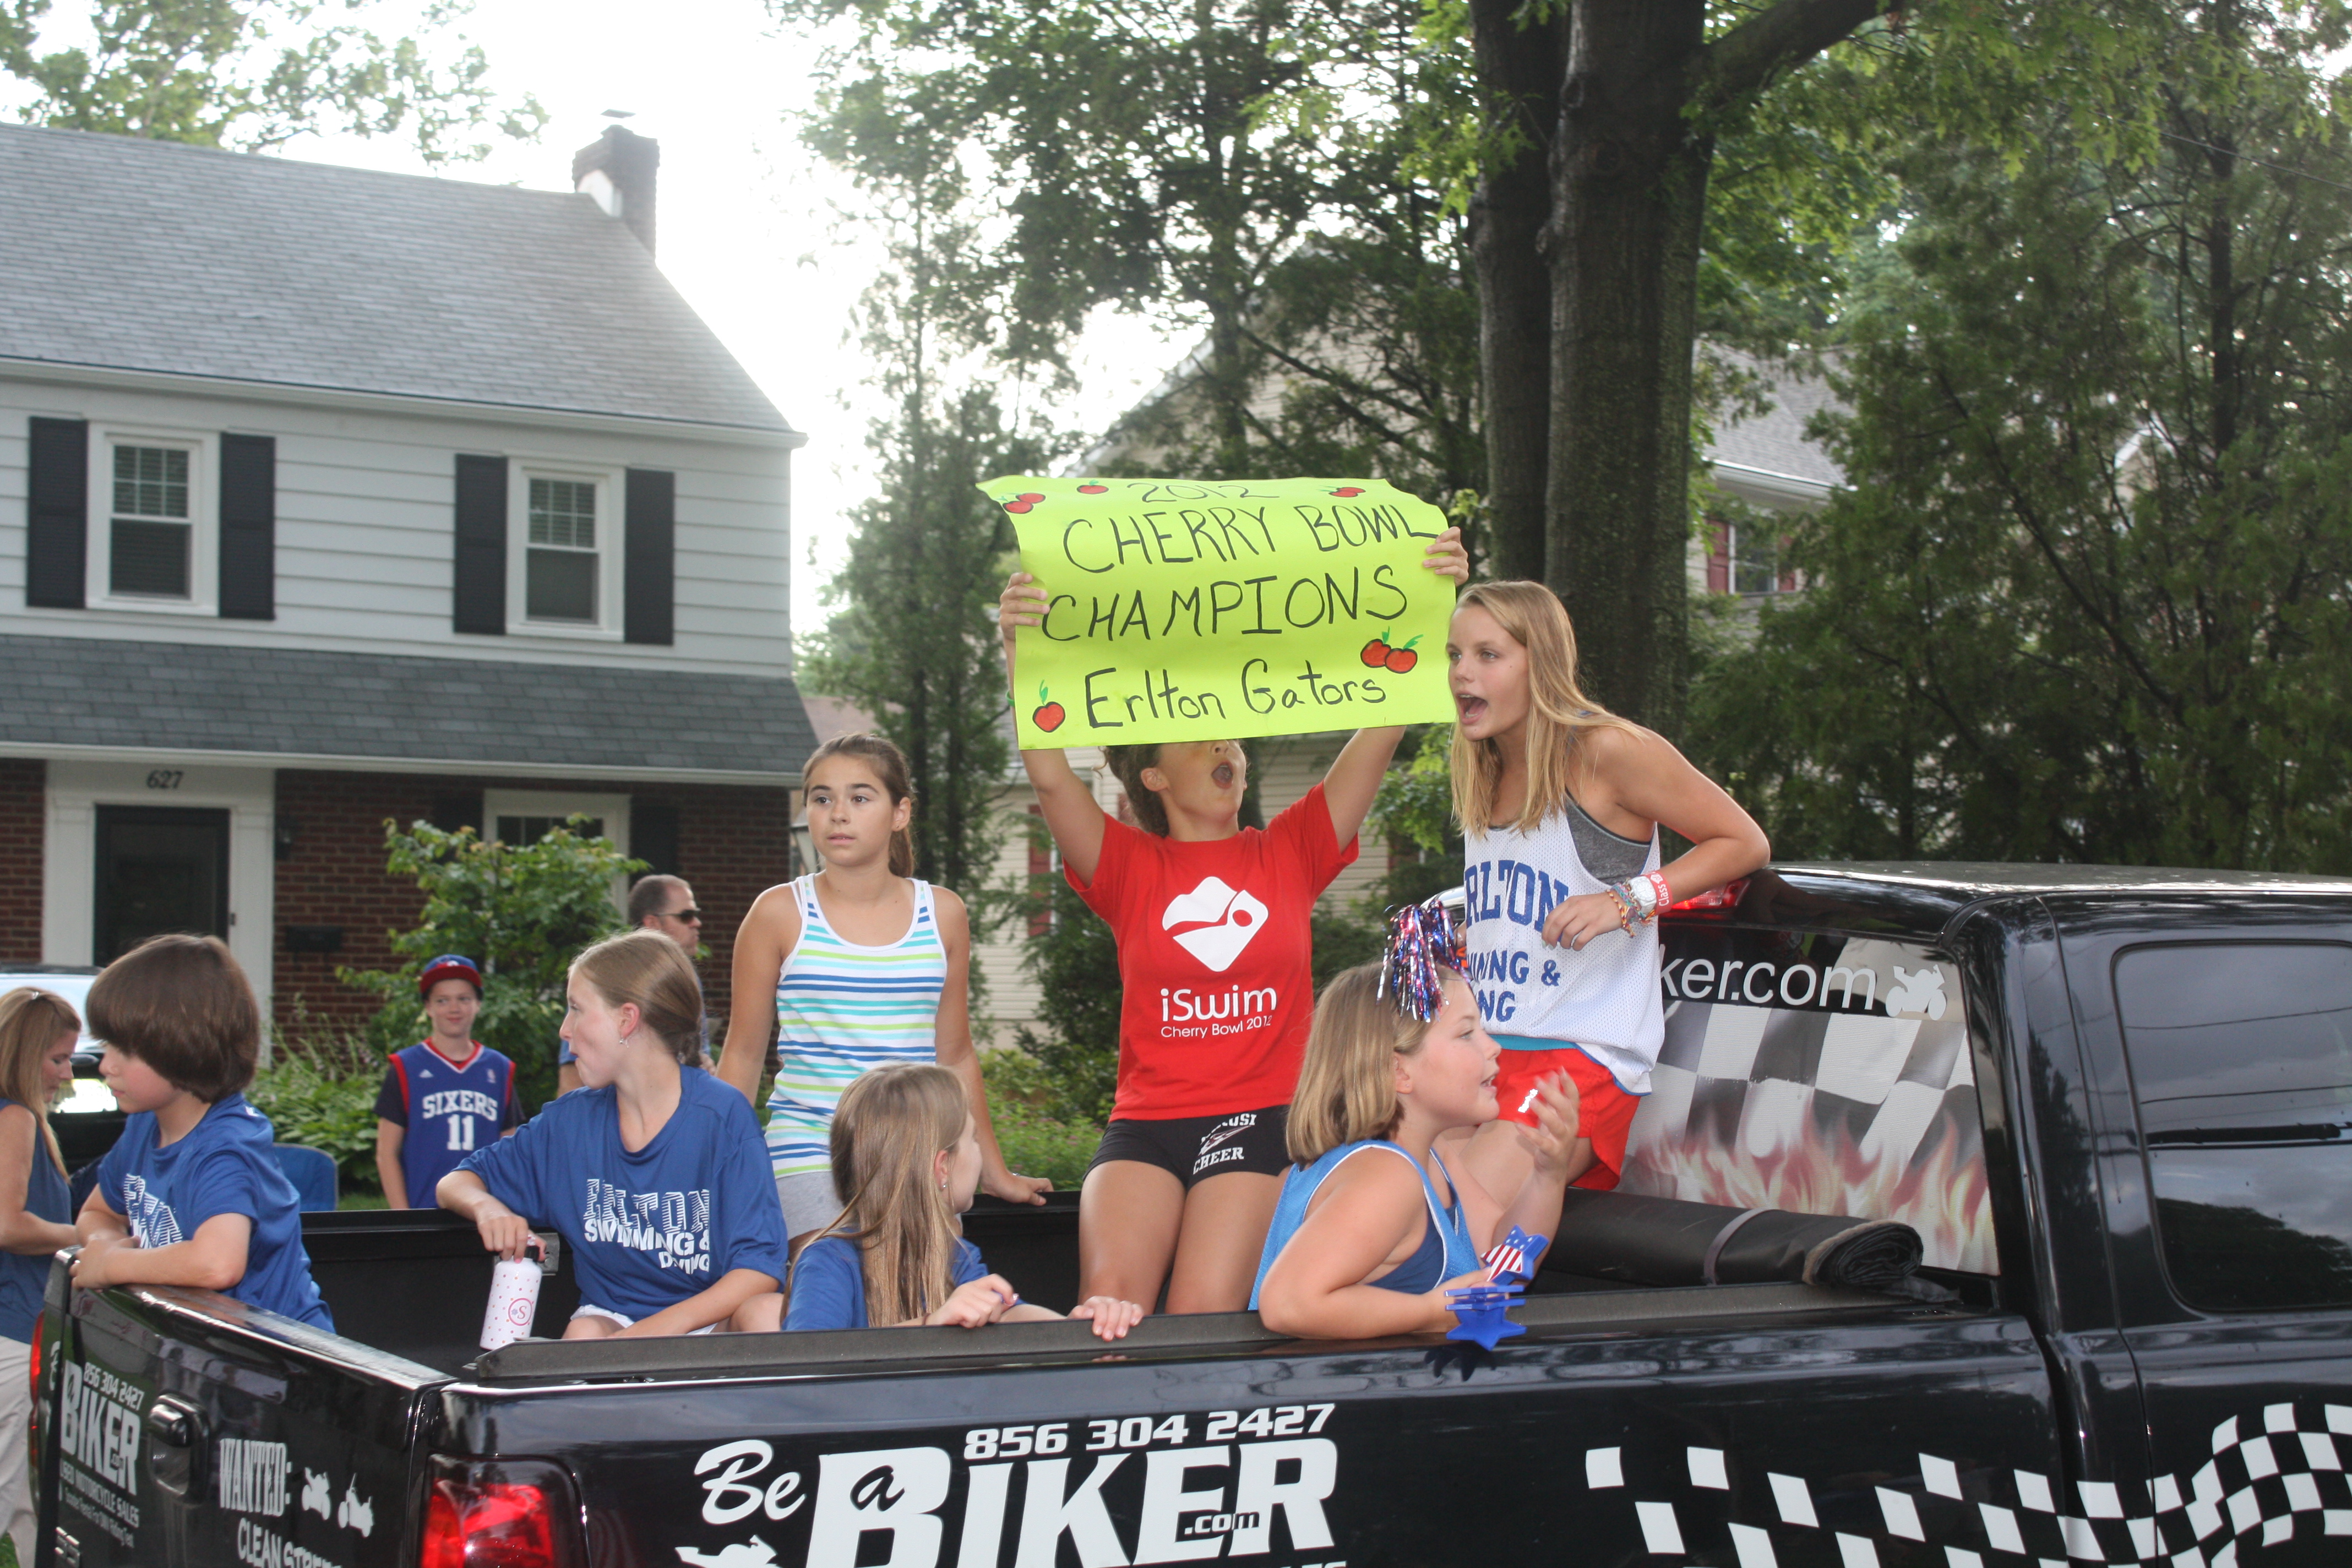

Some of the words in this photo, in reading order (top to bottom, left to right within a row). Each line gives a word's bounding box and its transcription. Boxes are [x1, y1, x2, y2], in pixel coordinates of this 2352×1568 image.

[1126, 482, 1280, 503] 2012
[1063, 505, 1276, 574] CHERRY
[1295, 504, 1439, 552] BOWL
[1041, 564, 1407, 642] CHAMPIONS
[1085, 667, 1226, 729] Erlton
[1241, 658, 1387, 715] Gators
[146, 770, 184, 789] 627
[1464, 860, 1569, 942] RLTON
[1657, 884, 1670, 907] Class
[1659, 943, 1876, 1011] ker.com
[1160, 984, 1277, 1022] iSwim
[1161, 1026, 1208, 1039] Cherry
[1212, 1020, 1243, 1036] Bowl
[422, 1090, 498, 1121] SIXERS
[447, 1113, 475, 1151] 11
[1193, 1147, 1245, 1175] CHEER
[84, 1362, 101, 1389] 856
[100, 1371, 119, 1398] 304
[118, 1381, 145, 1411] 2427
[60, 1359, 141, 1496] BIKER
[963, 1423, 1069, 1460] 856
[1086, 1415, 1189, 1451] 304
[1206, 1403, 1336, 1441] 2427
[694, 1439, 807, 1525] Be
[806, 1437, 1338, 1568] BIKER
[1184, 1511, 1260, 1536] .com
[237, 1517, 282, 1568] CLEAN
